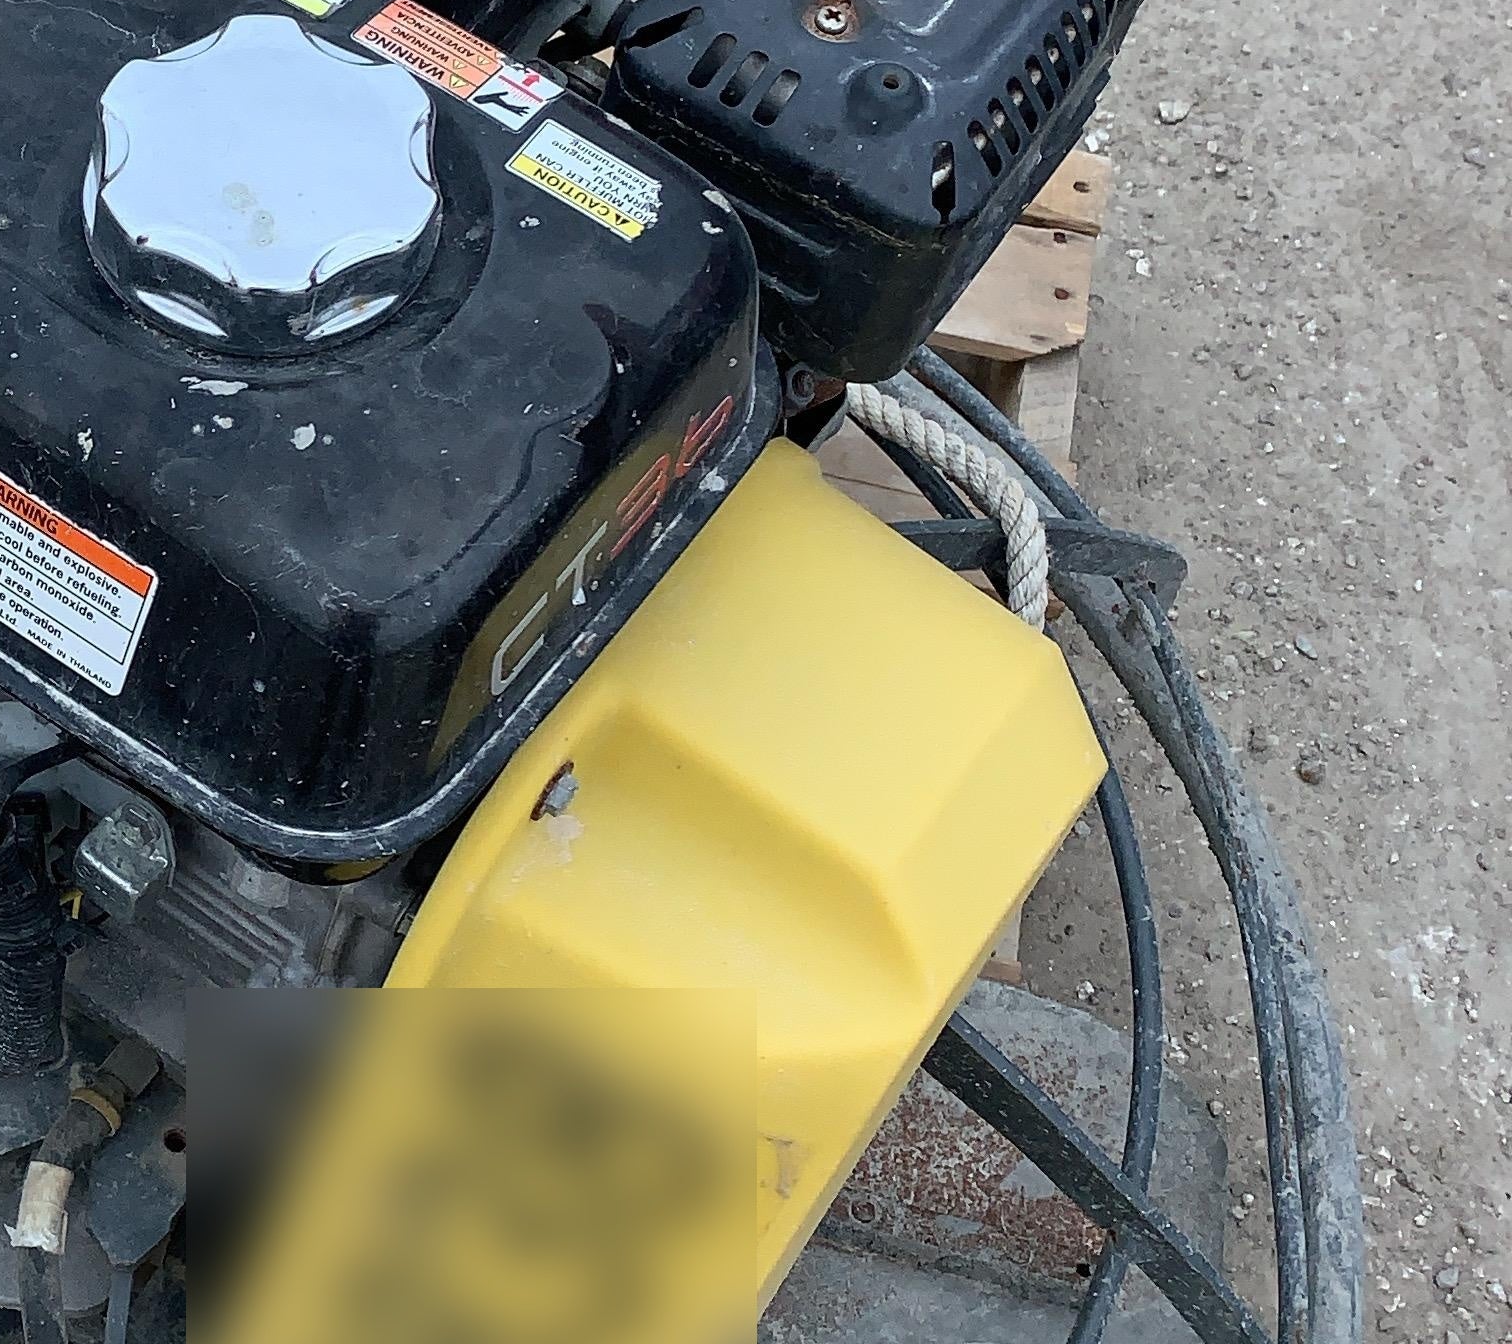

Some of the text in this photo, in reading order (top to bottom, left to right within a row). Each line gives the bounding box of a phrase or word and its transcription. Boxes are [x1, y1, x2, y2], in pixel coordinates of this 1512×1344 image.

[390, 25, 450, 63] WARNUNG
[396, 7, 476, 61] ADVERTENCIA
[364, 29, 445, 81] WARNING
[534, 152, 563, 172] CAN
[551, 140, 591, 165] engine
[591, 164, 603, 172] if
[532, 167, 610, 217] CAUTION
[565, 169, 625, 208] MUFFLER
[604, 170, 636, 192] away
[617, 167, 648, 190] been
[3, 575, 34, 601] area.
[24, 546, 64, 579] before
[66, 575, 122, 619] refueling.
[37, 538, 62, 559] and
[63, 555, 122, 599] explosive.
[8, 598, 64, 641] operation.
[35, 577, 97, 624] monoxide.
[26, 628, 53, 650] MADE
[55, 648, 67, 659] IN
[69, 656, 112, 689] THAILAND
